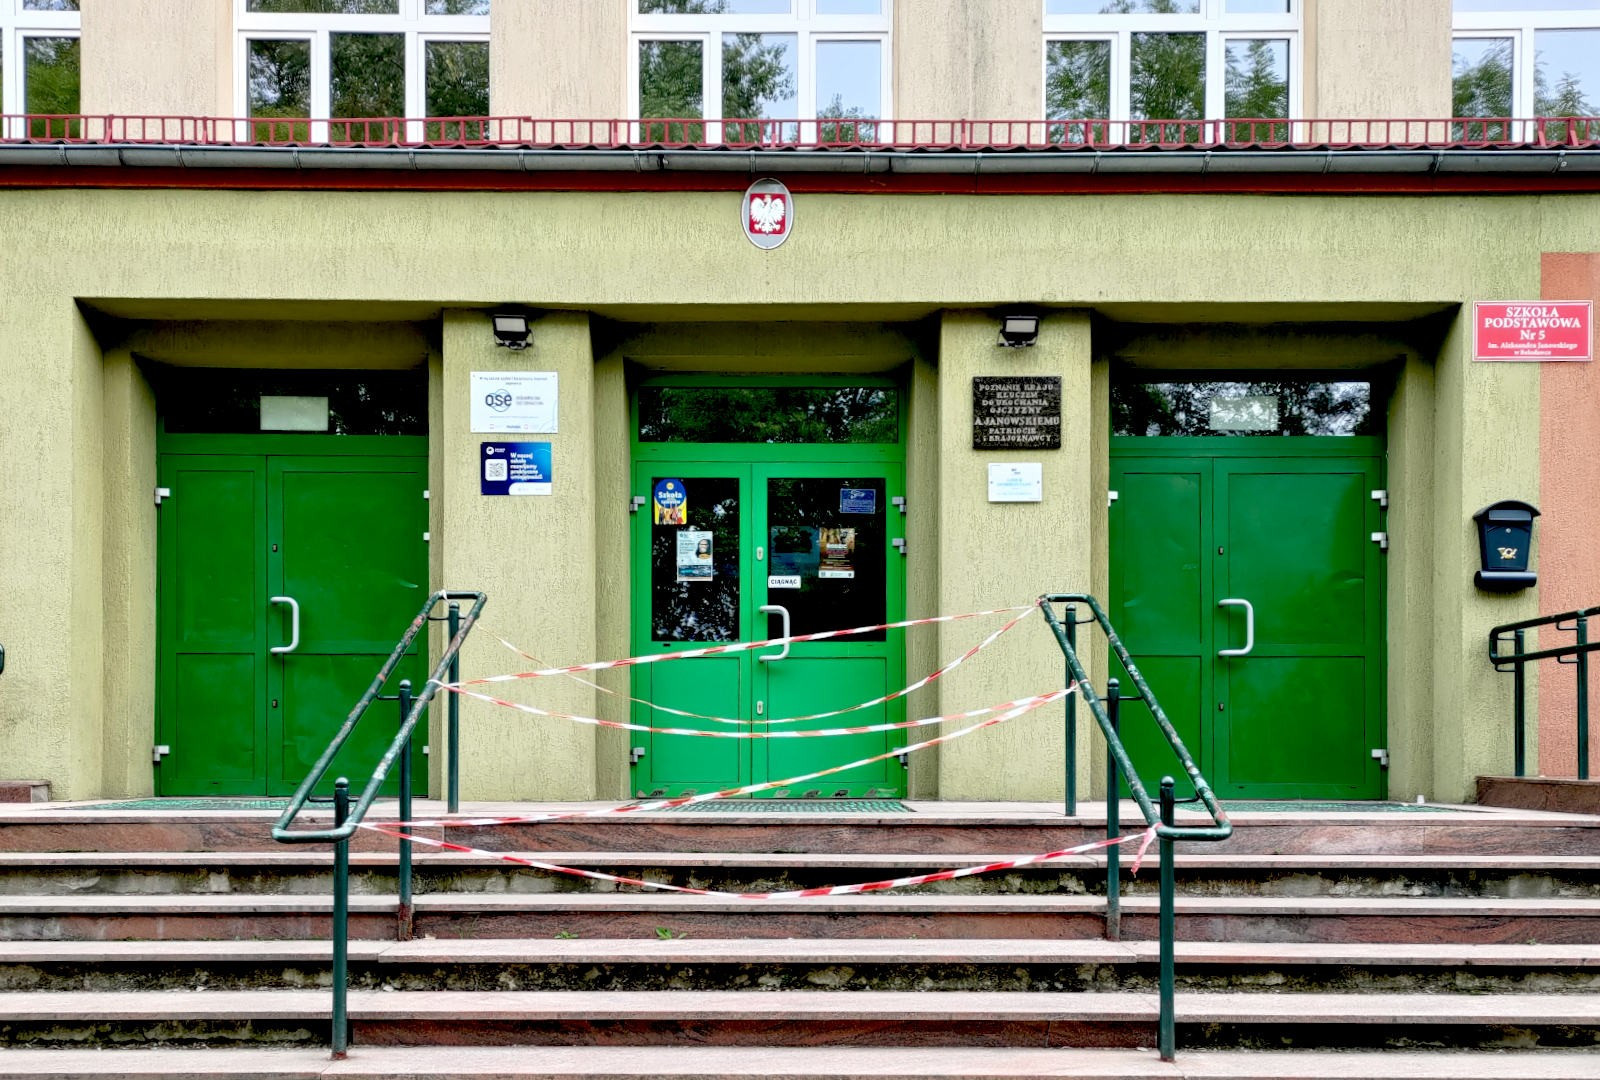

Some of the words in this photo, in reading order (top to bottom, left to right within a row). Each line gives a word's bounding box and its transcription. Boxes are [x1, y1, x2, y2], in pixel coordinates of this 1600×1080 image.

[1506, 306, 1559, 317] SZKOŁA
[1484, 317, 1581, 328] PODSTAWOWA
[1520, 330, 1536, 340] Nr
[1538, 330, 1546, 340] 5
[1538, 342, 1578, 350] Janowskiego
[485, 394, 512, 406] ose
